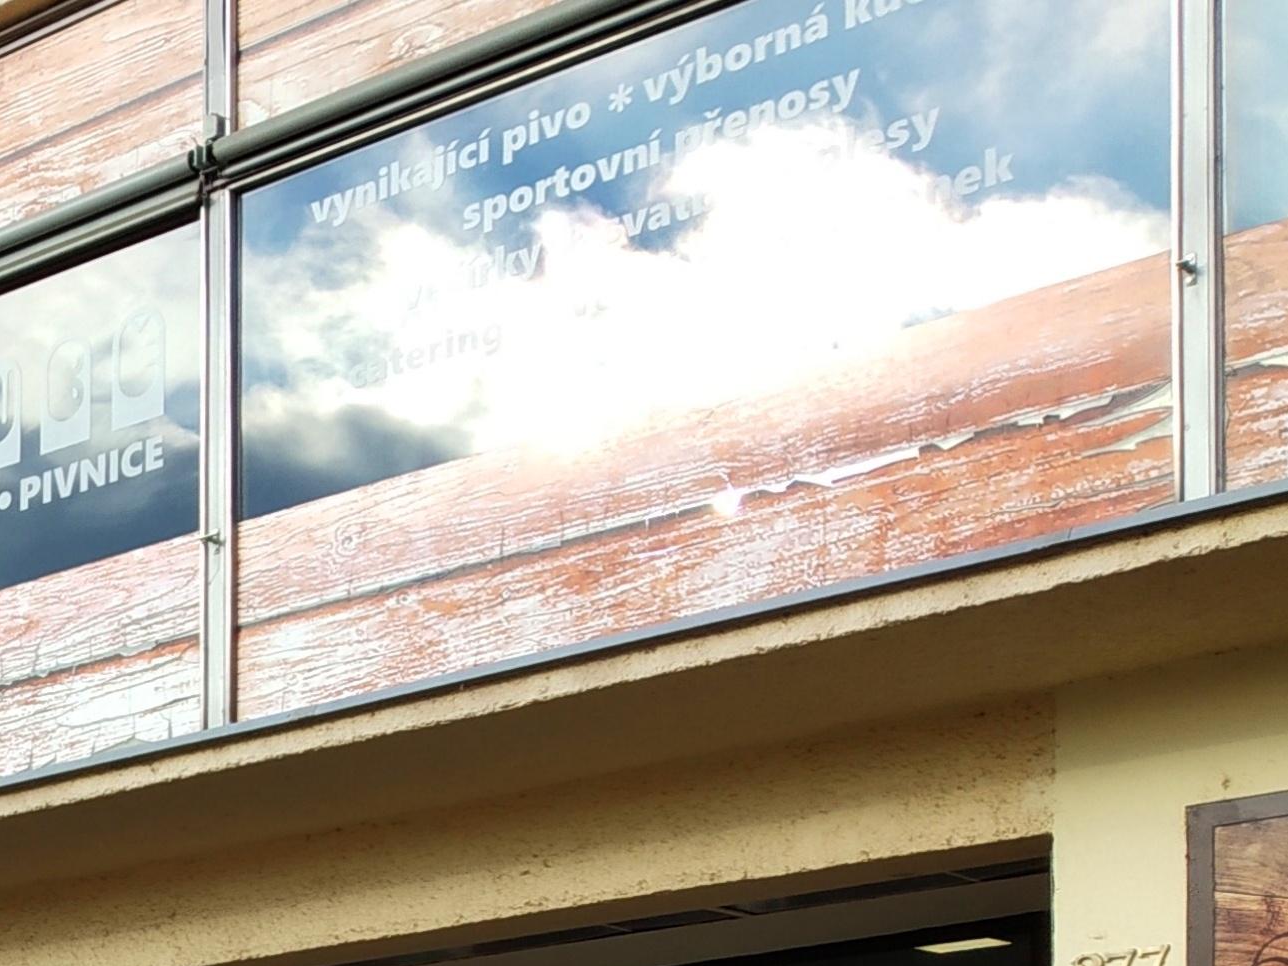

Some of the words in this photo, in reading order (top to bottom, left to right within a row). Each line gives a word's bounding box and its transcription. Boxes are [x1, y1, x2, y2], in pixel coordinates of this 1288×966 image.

[310, 129, 492, 226] vynikající
[502, 102, 592, 164] pivo
[643, 0, 829, 105] výborná
[462, 129, 663, 233] sportovní
[674, 68, 861, 156] přenosy
[350, 321, 503, 389] catering
[19, 434, 165, 511] PIVNICE
